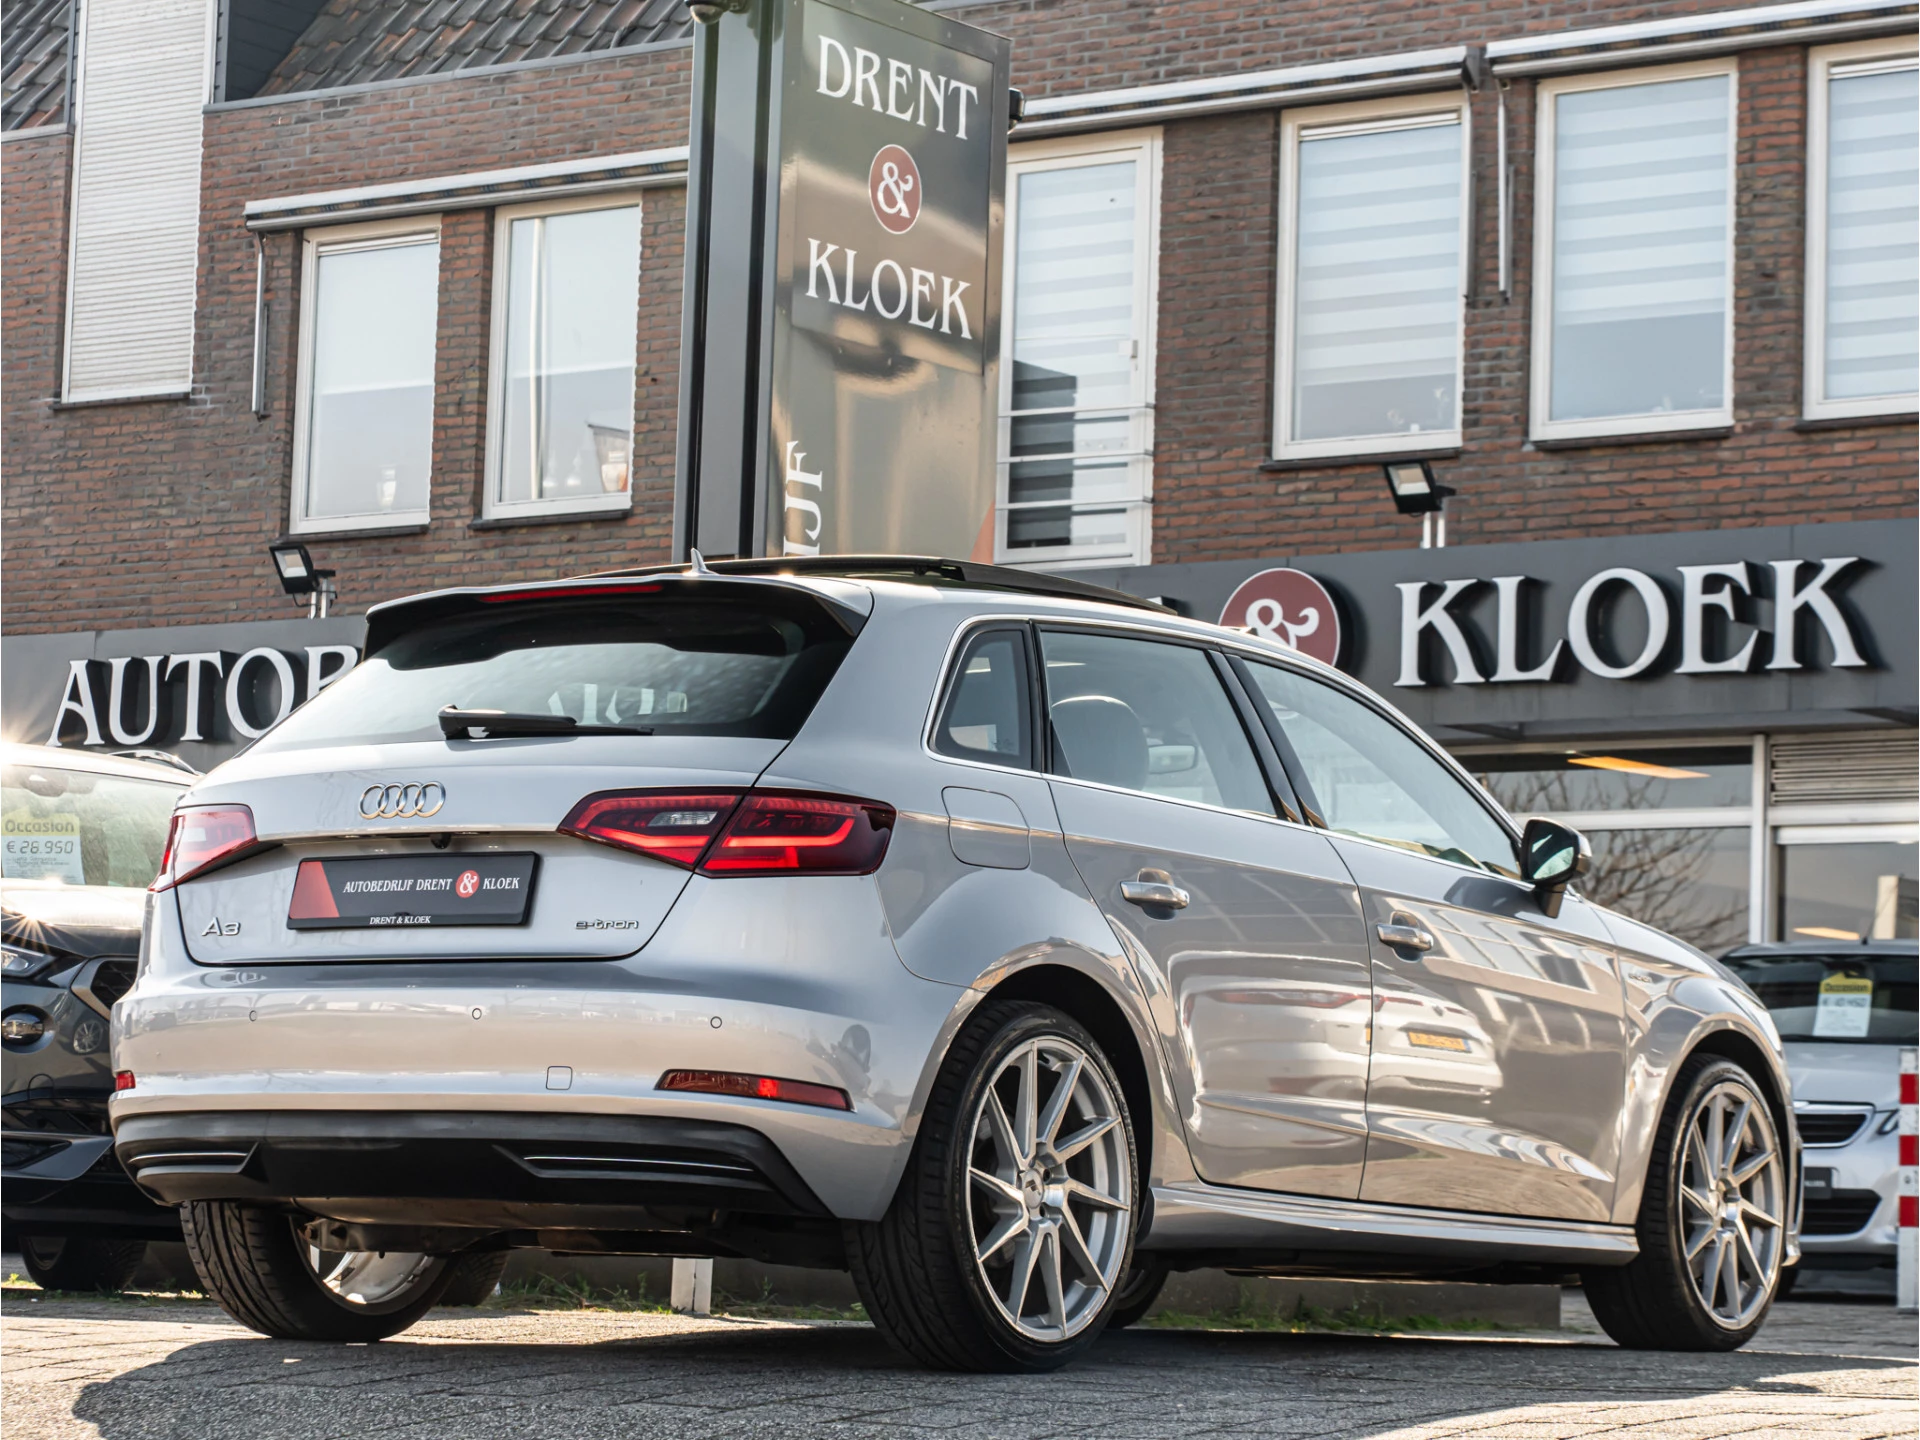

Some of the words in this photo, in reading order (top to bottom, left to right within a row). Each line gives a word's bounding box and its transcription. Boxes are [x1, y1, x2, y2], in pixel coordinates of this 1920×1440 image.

[816, 34, 979, 140] DRENT
[876, 161, 914, 219] &
[805, 237, 974, 340] KLOEK
[1394, 556, 1868, 687] KLOEK
[4, 819, 75, 833] Occasion
[6, 840, 17, 854] €
[342, 879, 414, 894] AUTOBEDRIJF
[416, 878, 453, 891] DRENT
[459, 872, 478, 894] &
[482, 877, 520, 890] KLOEK
[201, 916, 241, 937] A3
[369, 916, 396, 925] DRENT
[403, 916, 431, 924] KLOEK
[575, 919, 639, 930] e-tron
